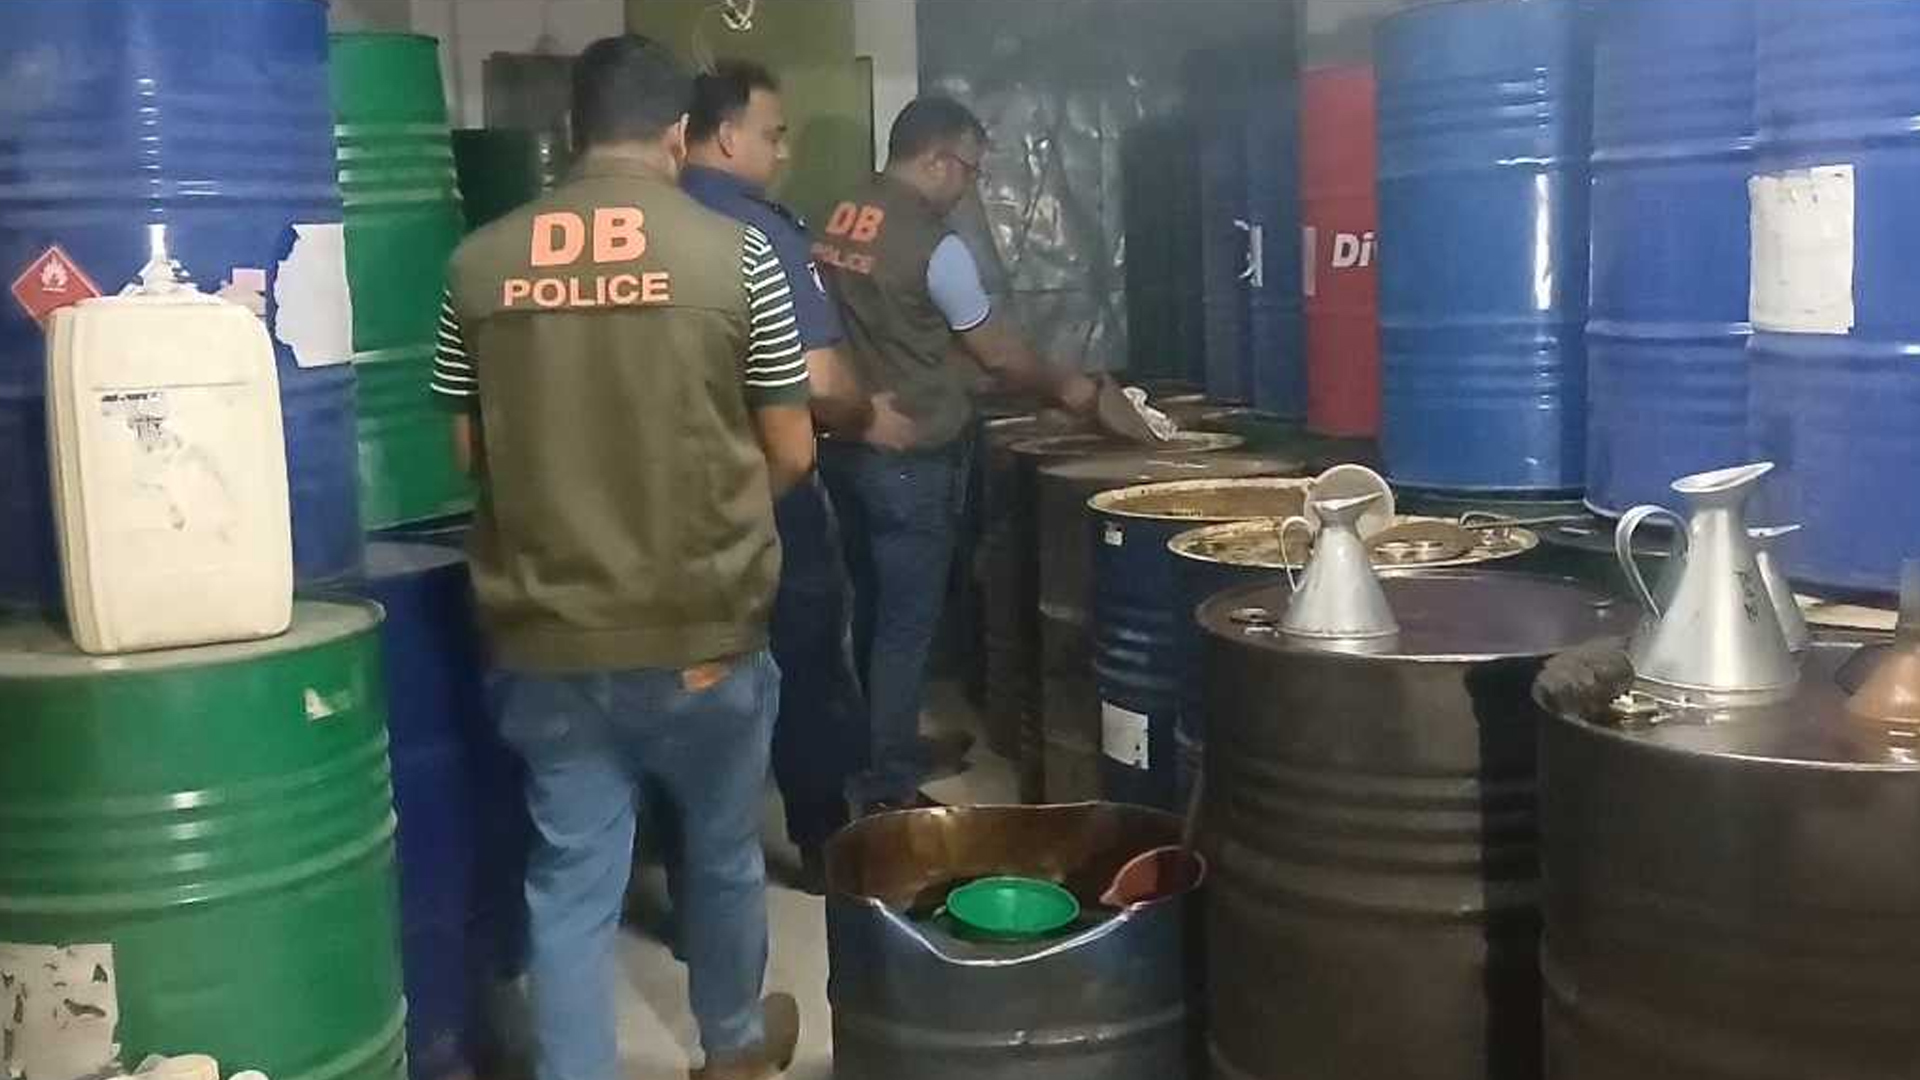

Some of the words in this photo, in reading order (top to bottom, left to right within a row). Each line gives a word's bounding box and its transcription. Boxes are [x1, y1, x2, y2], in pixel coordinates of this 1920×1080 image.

[531, 206, 646, 266] DB
[825, 201, 884, 241] DB
[809, 242, 874, 275] POLICE
[1331, 231, 1378, 268] Di
[503, 271, 670, 308] POLICE
